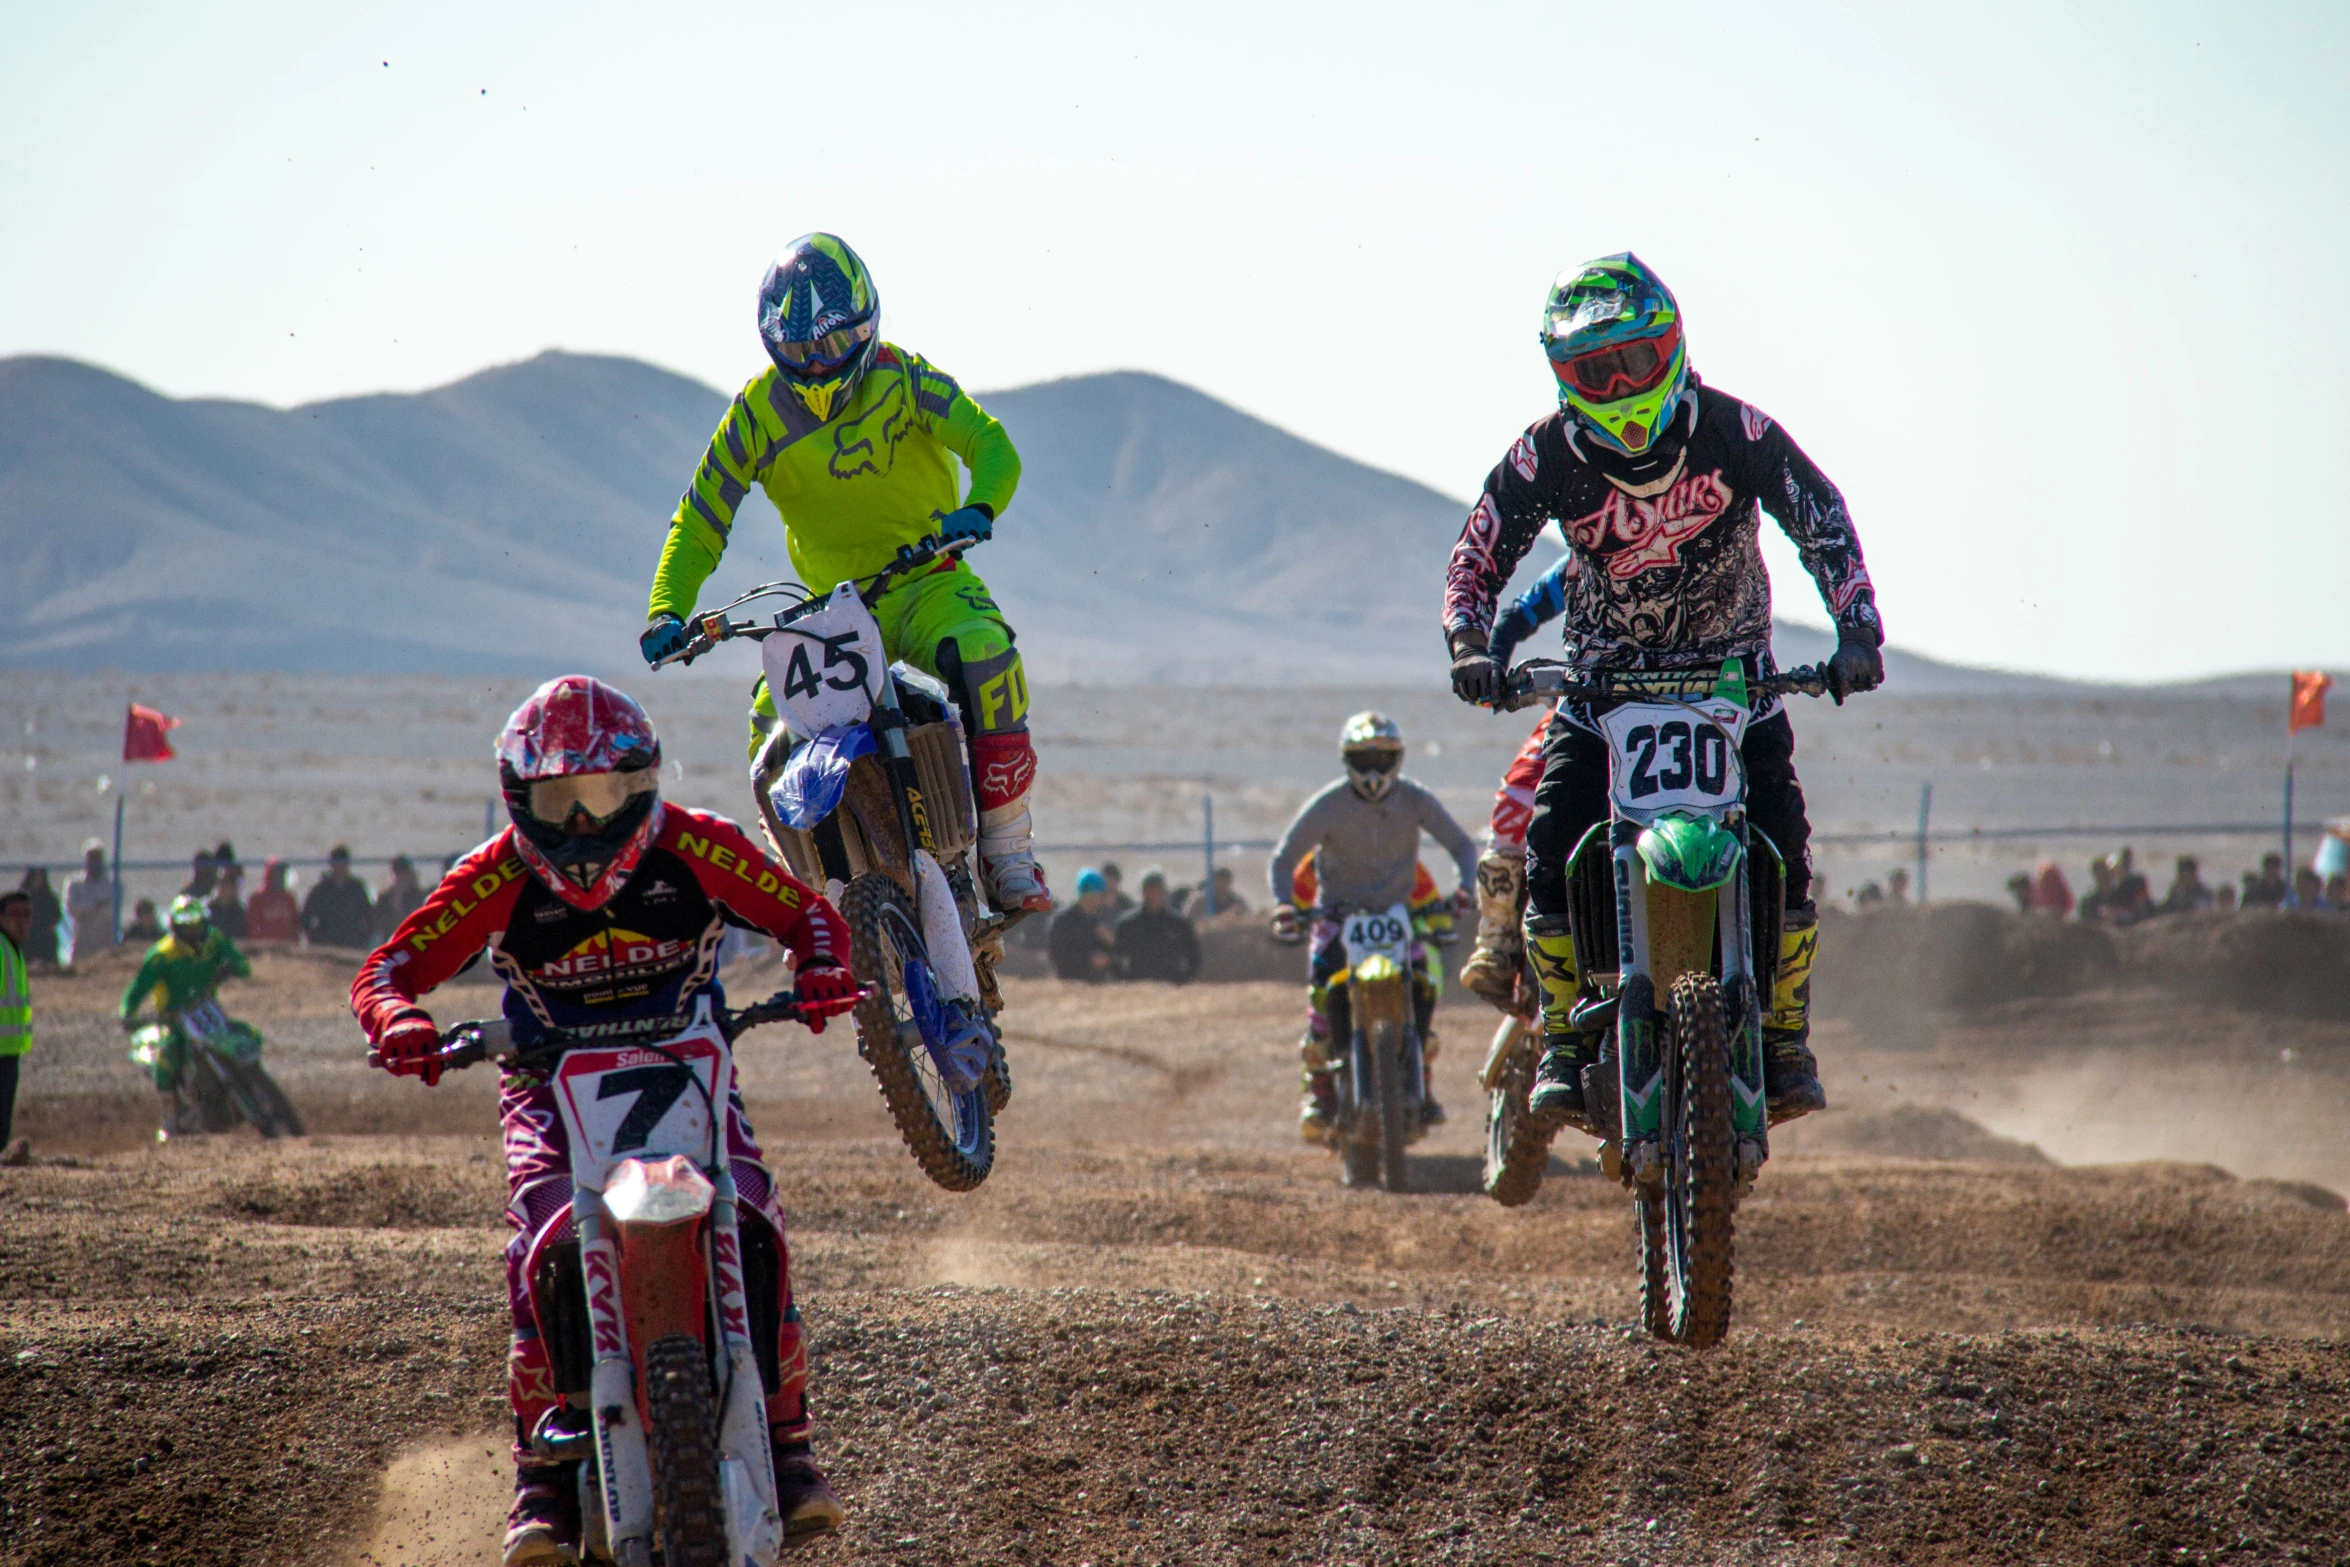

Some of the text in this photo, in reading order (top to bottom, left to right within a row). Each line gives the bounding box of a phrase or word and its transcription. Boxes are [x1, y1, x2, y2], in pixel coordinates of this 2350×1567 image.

[813, 313, 847, 341] Airoh
[784, 631, 869, 701] 45
[1626, 721, 1727, 800] 230
[411, 857, 528, 952] NELDE
[676, 831, 802, 910] NELDE
[544, 939, 680, 976] NELDE
[1350, 917, 1404, 944] 409
[596, 1065, 693, 1156] 7
[585, 1250, 622, 1352] KYB
